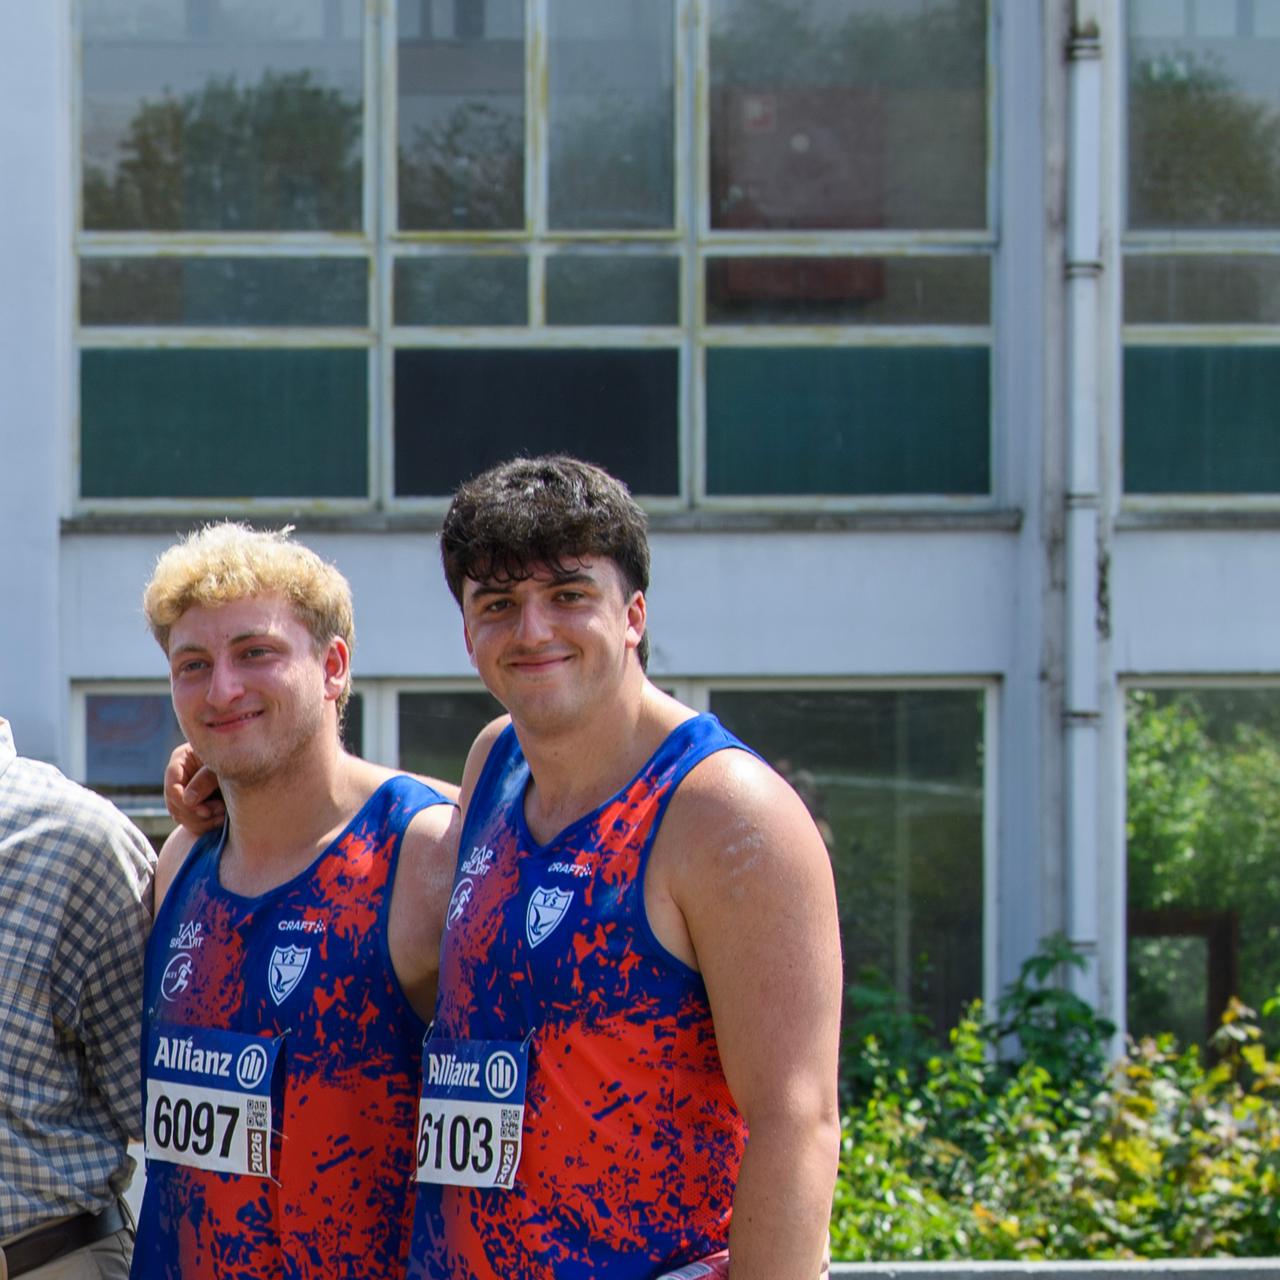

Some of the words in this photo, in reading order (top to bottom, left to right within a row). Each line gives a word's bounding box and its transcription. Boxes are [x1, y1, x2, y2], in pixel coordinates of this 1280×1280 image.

[548, 862, 584, 874] CRAFT
[278, 920, 315, 932] CRAFT
[153, 1036, 232, 1077] Allianz
[428, 1053, 480, 1088] Allianz
[153, 1095, 240, 1158] 6097
[417, 1112, 493, 1173] 6103
[251, 1132, 263, 1172] 2026
[497, 1144, 515, 1183] 2026
